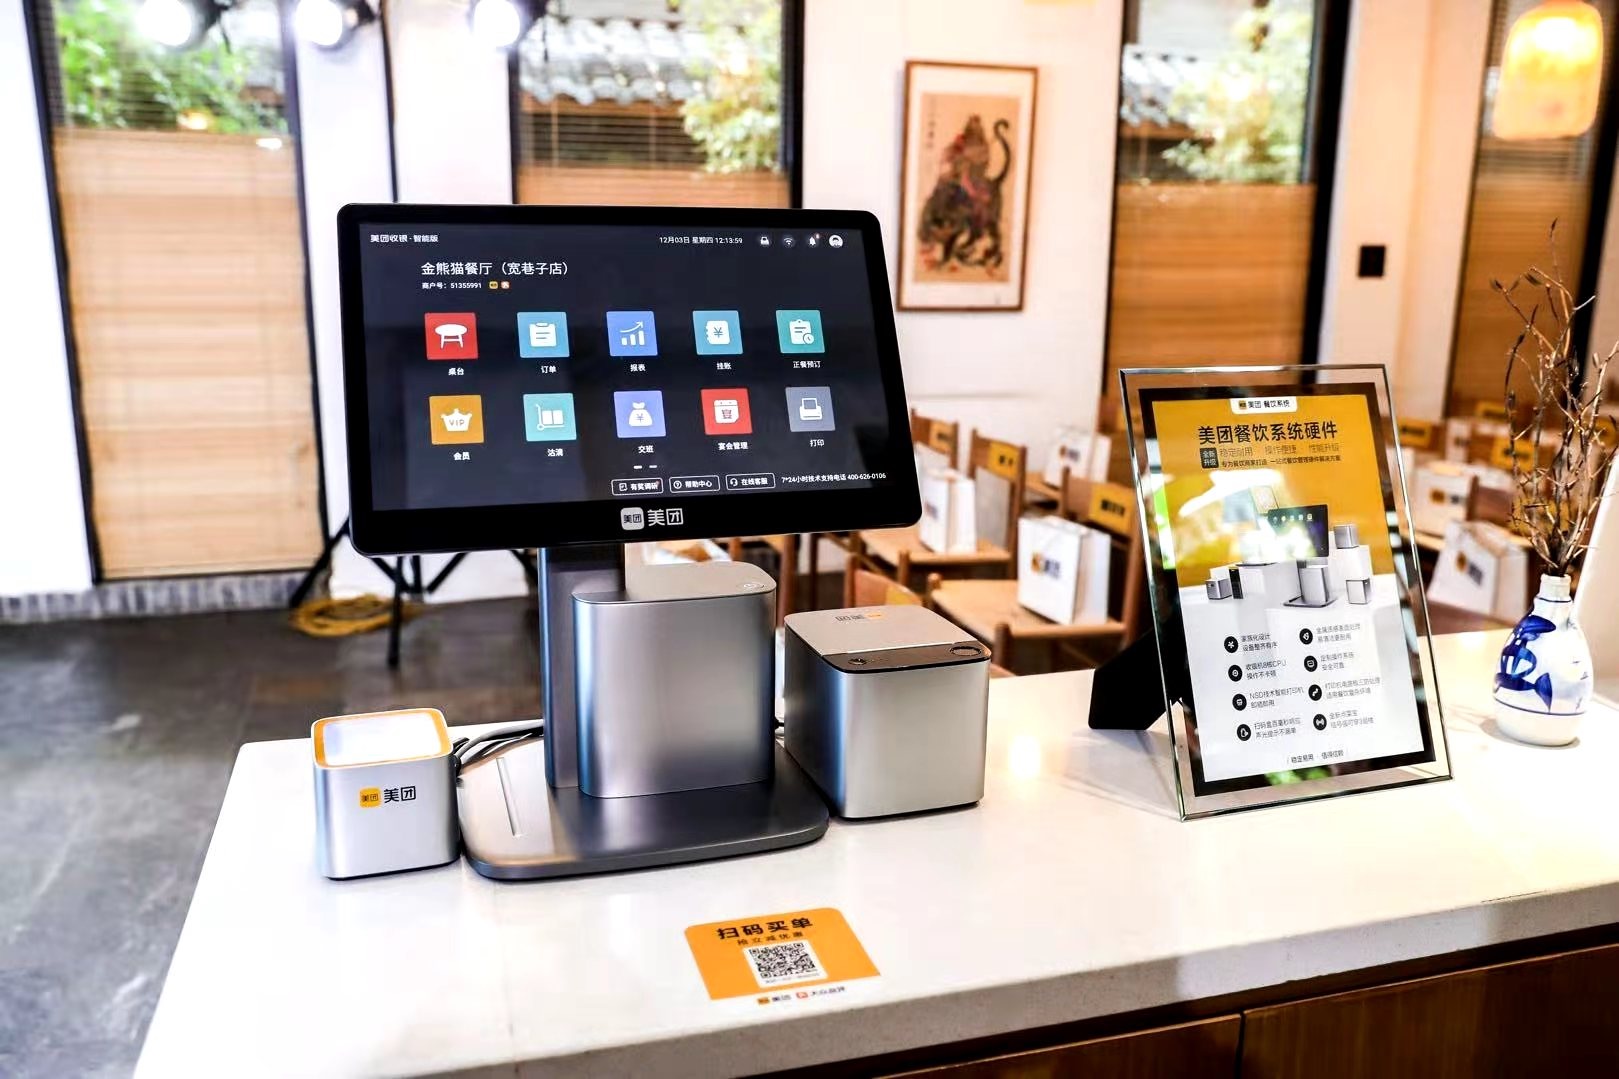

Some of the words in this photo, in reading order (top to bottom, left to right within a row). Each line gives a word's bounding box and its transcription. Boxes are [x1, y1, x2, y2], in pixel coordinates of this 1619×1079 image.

[659, 236, 690, 244] 12月03日
[692, 236, 713, 244] 星期四
[420, 261, 568, 276] 金熊猫餐厅（宽巷子店）
[630, 363, 646, 372] 报表
[716, 362, 732, 370] 挂账
[793, 360, 821, 369] 正餐预订
[448, 367, 464, 376] 桌台
[541, 365, 556, 374] 订单
[1198, 420, 1338, 445] 美团餐饮系统硬件
[718, 442, 748, 451] 宴会管理
[809, 439, 825, 447] 打印
[638, 445, 654, 453] 交班
[453, 452, 470, 461] 会员
[685, 480, 712, 488] 帮助中心
[741, 477, 768, 486] 在线客服
[623, 513, 642, 523] 美团
[647, 507, 684, 526] 美团
[384, 785, 416, 804] 美团
[716, 916, 814, 940] 扫码买单
